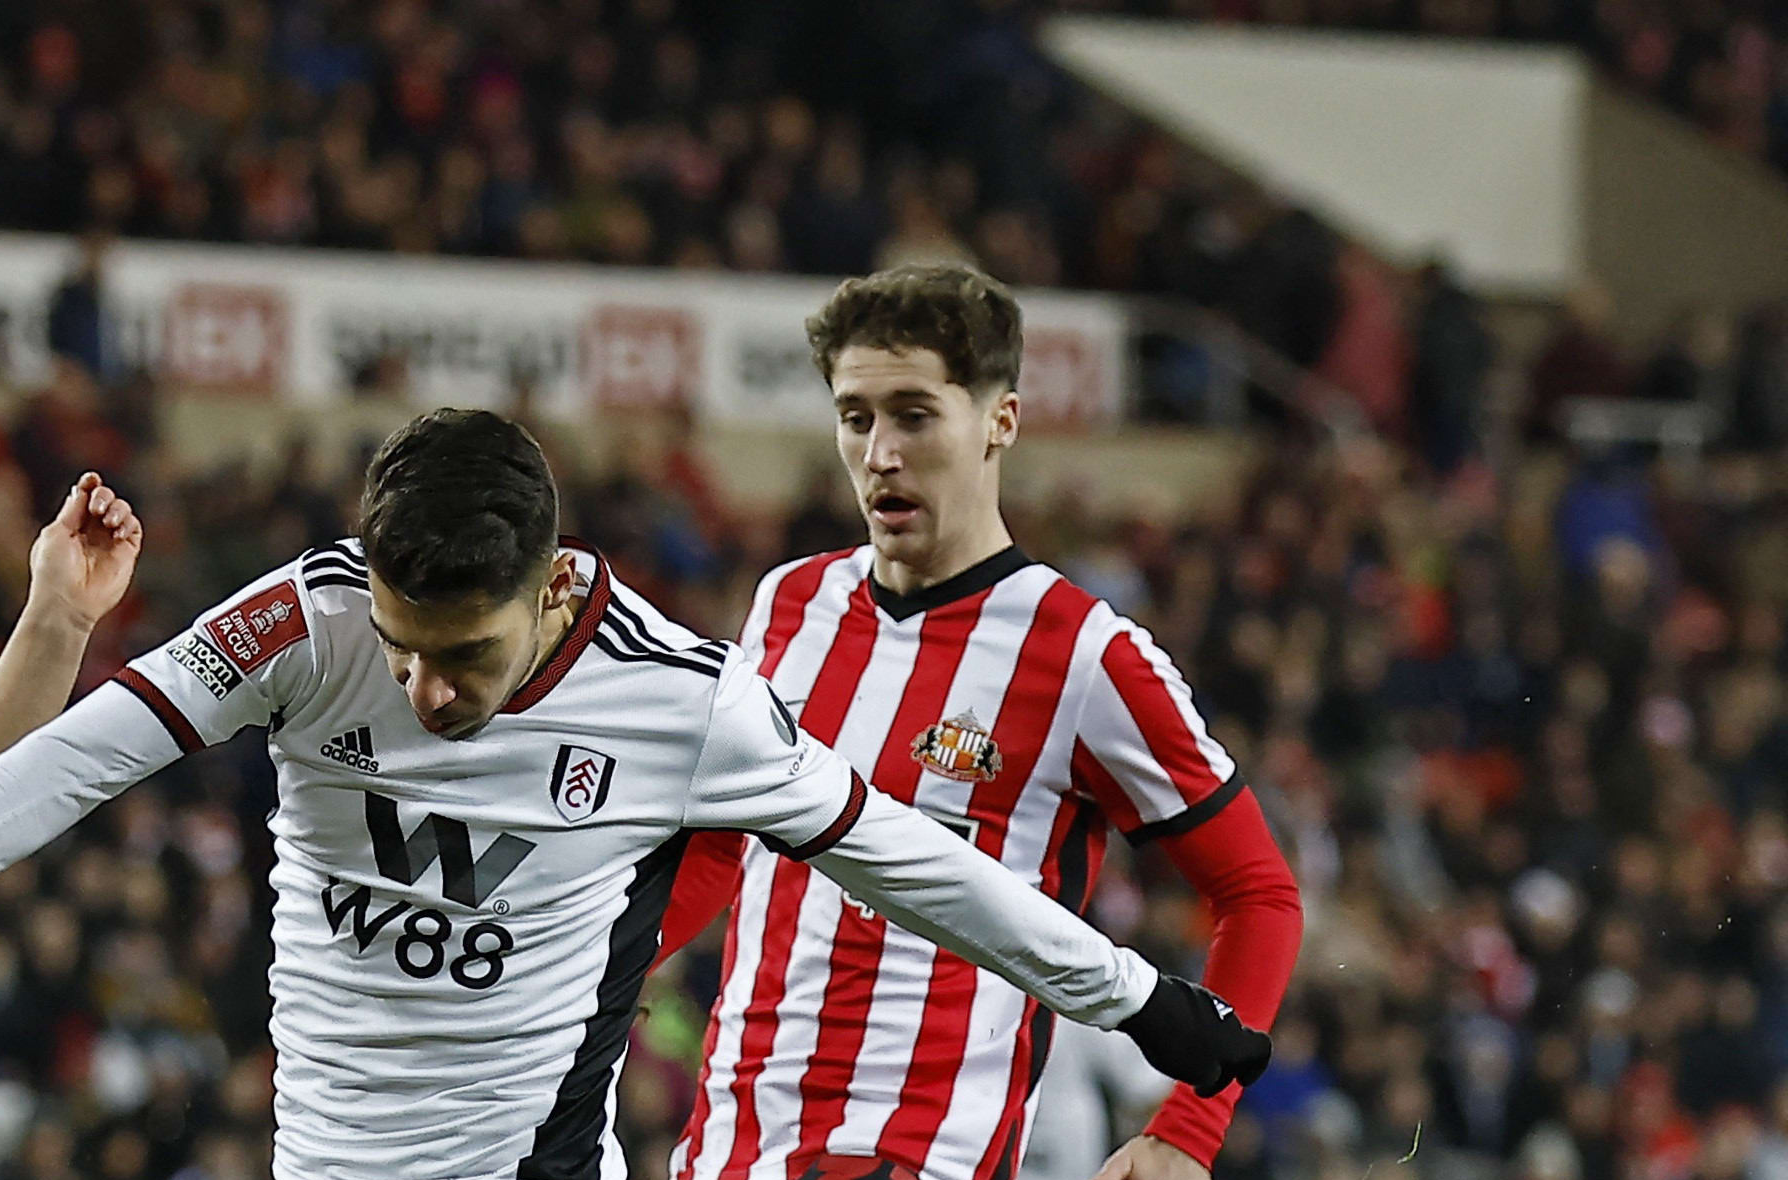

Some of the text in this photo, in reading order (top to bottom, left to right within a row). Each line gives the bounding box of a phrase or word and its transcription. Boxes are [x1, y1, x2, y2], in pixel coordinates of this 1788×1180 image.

[217, 616, 251, 662] FA CUP
[229, 609, 261, 655] Emirates
[192, 642, 232, 683] room
[320, 744, 379, 773] adidas
[565, 758, 599, 808] FFC
[321, 875, 513, 990] W88
